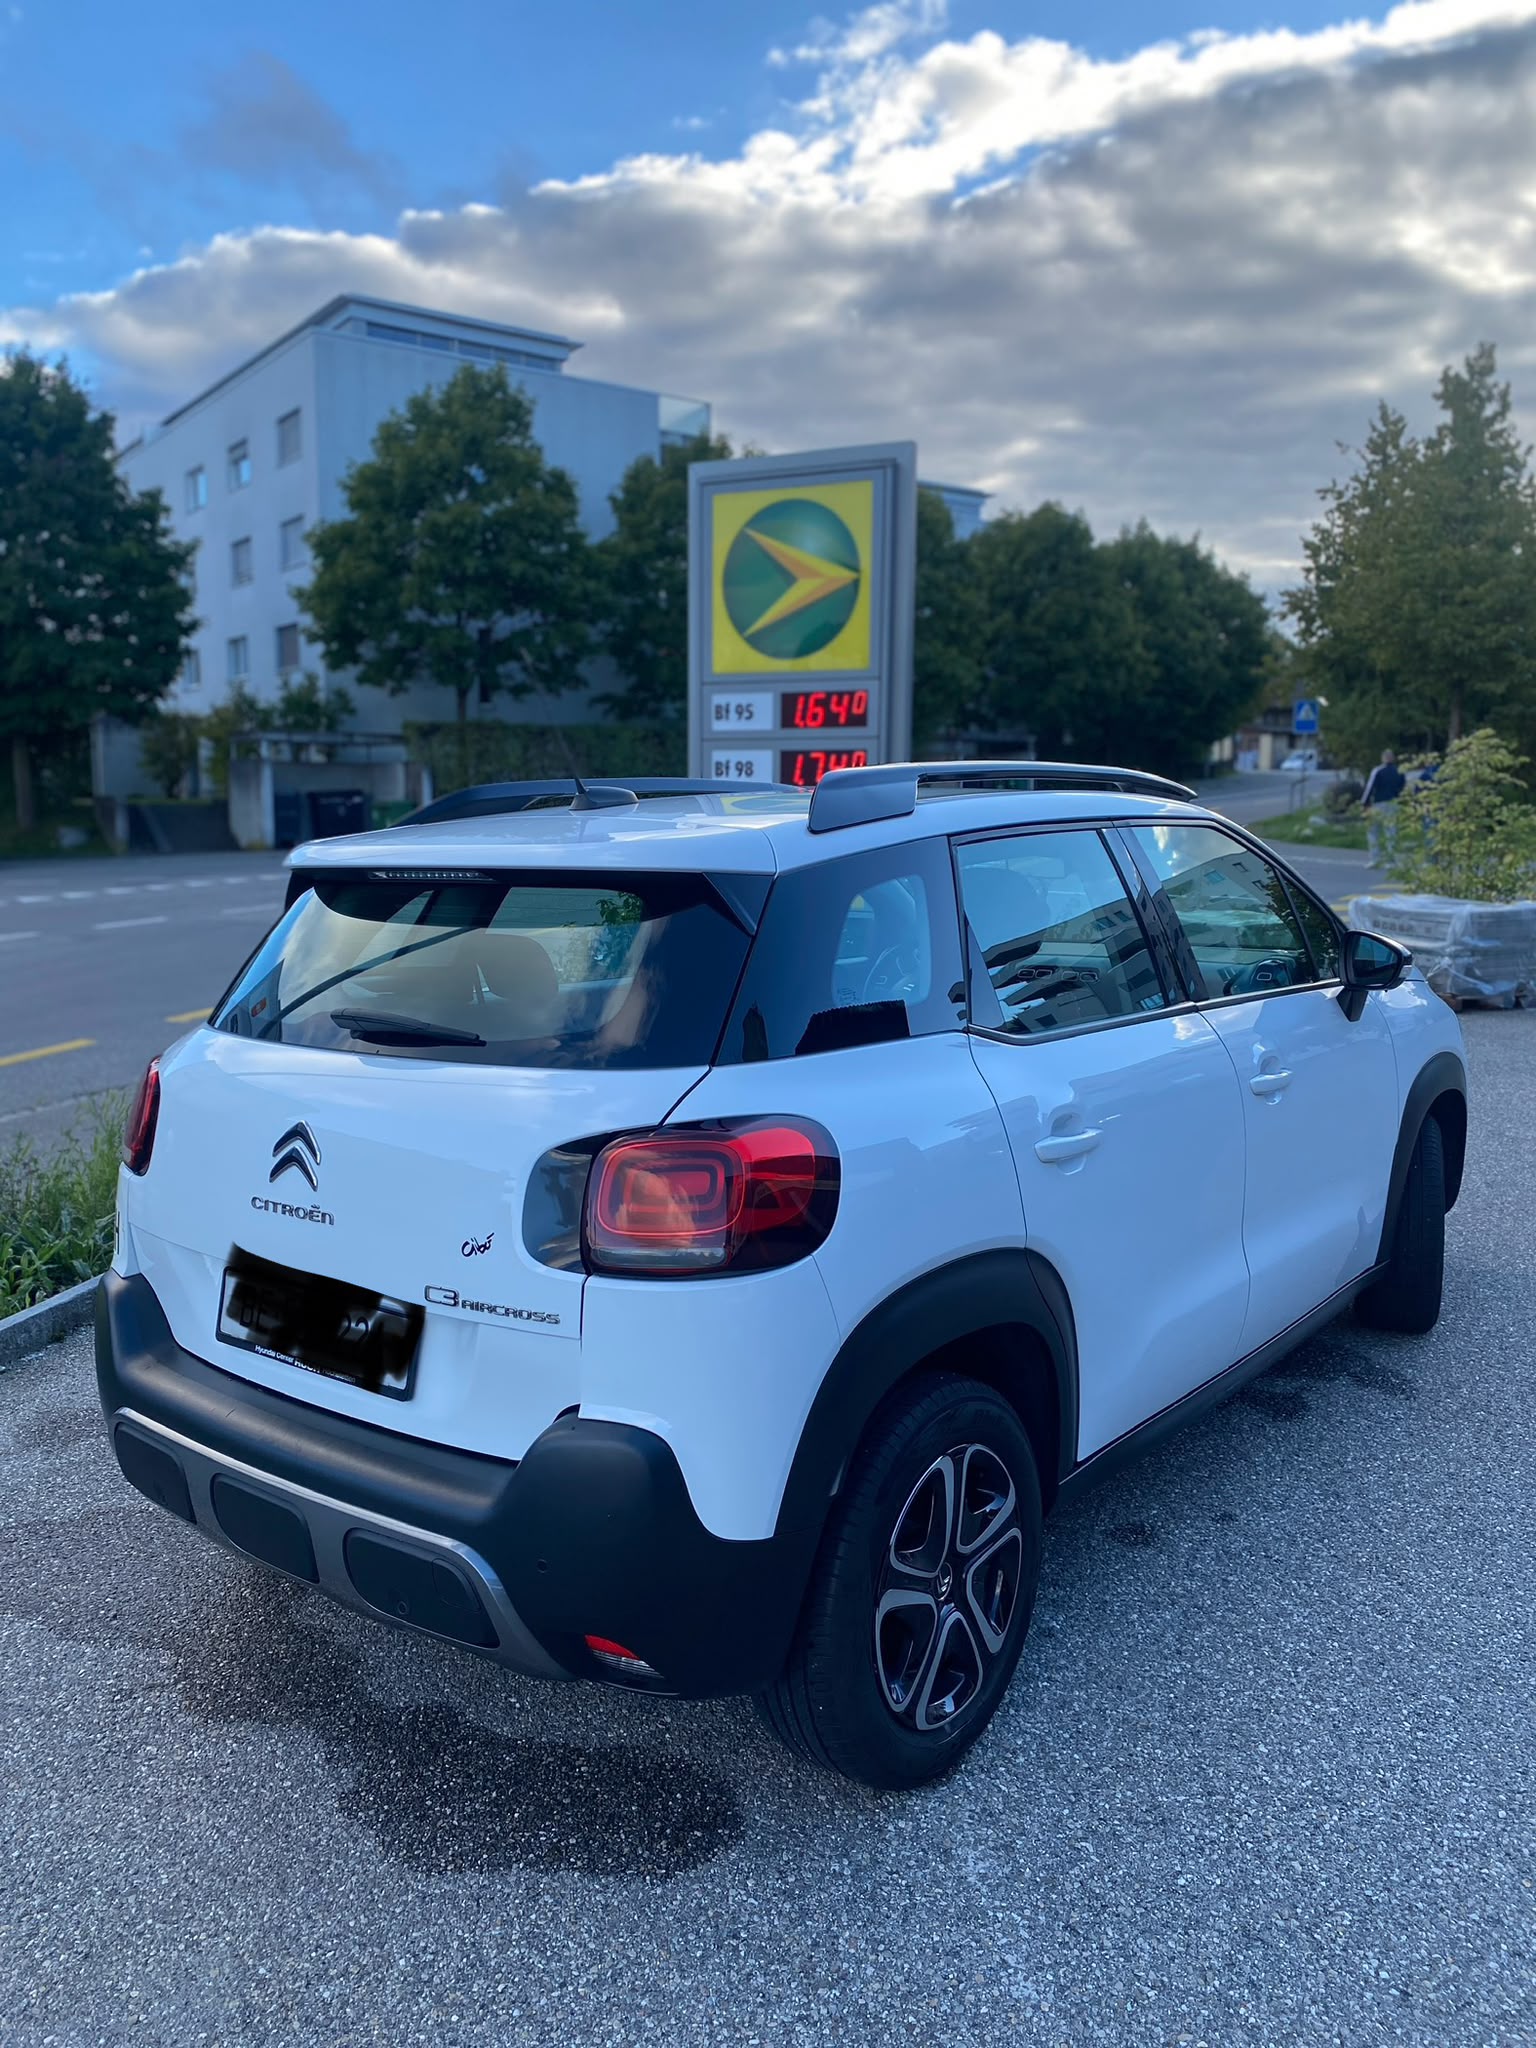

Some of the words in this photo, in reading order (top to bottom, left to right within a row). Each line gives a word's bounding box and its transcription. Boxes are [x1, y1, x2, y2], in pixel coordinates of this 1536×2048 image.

[714, 703, 730, 721] Bf
[735, 703, 754, 721] 95
[714, 760, 730, 778] Bf
[735, 760, 754, 778] 98
[424, 1284, 460, 1308] C3
[461, 1299, 561, 1325] AIRCROSS
